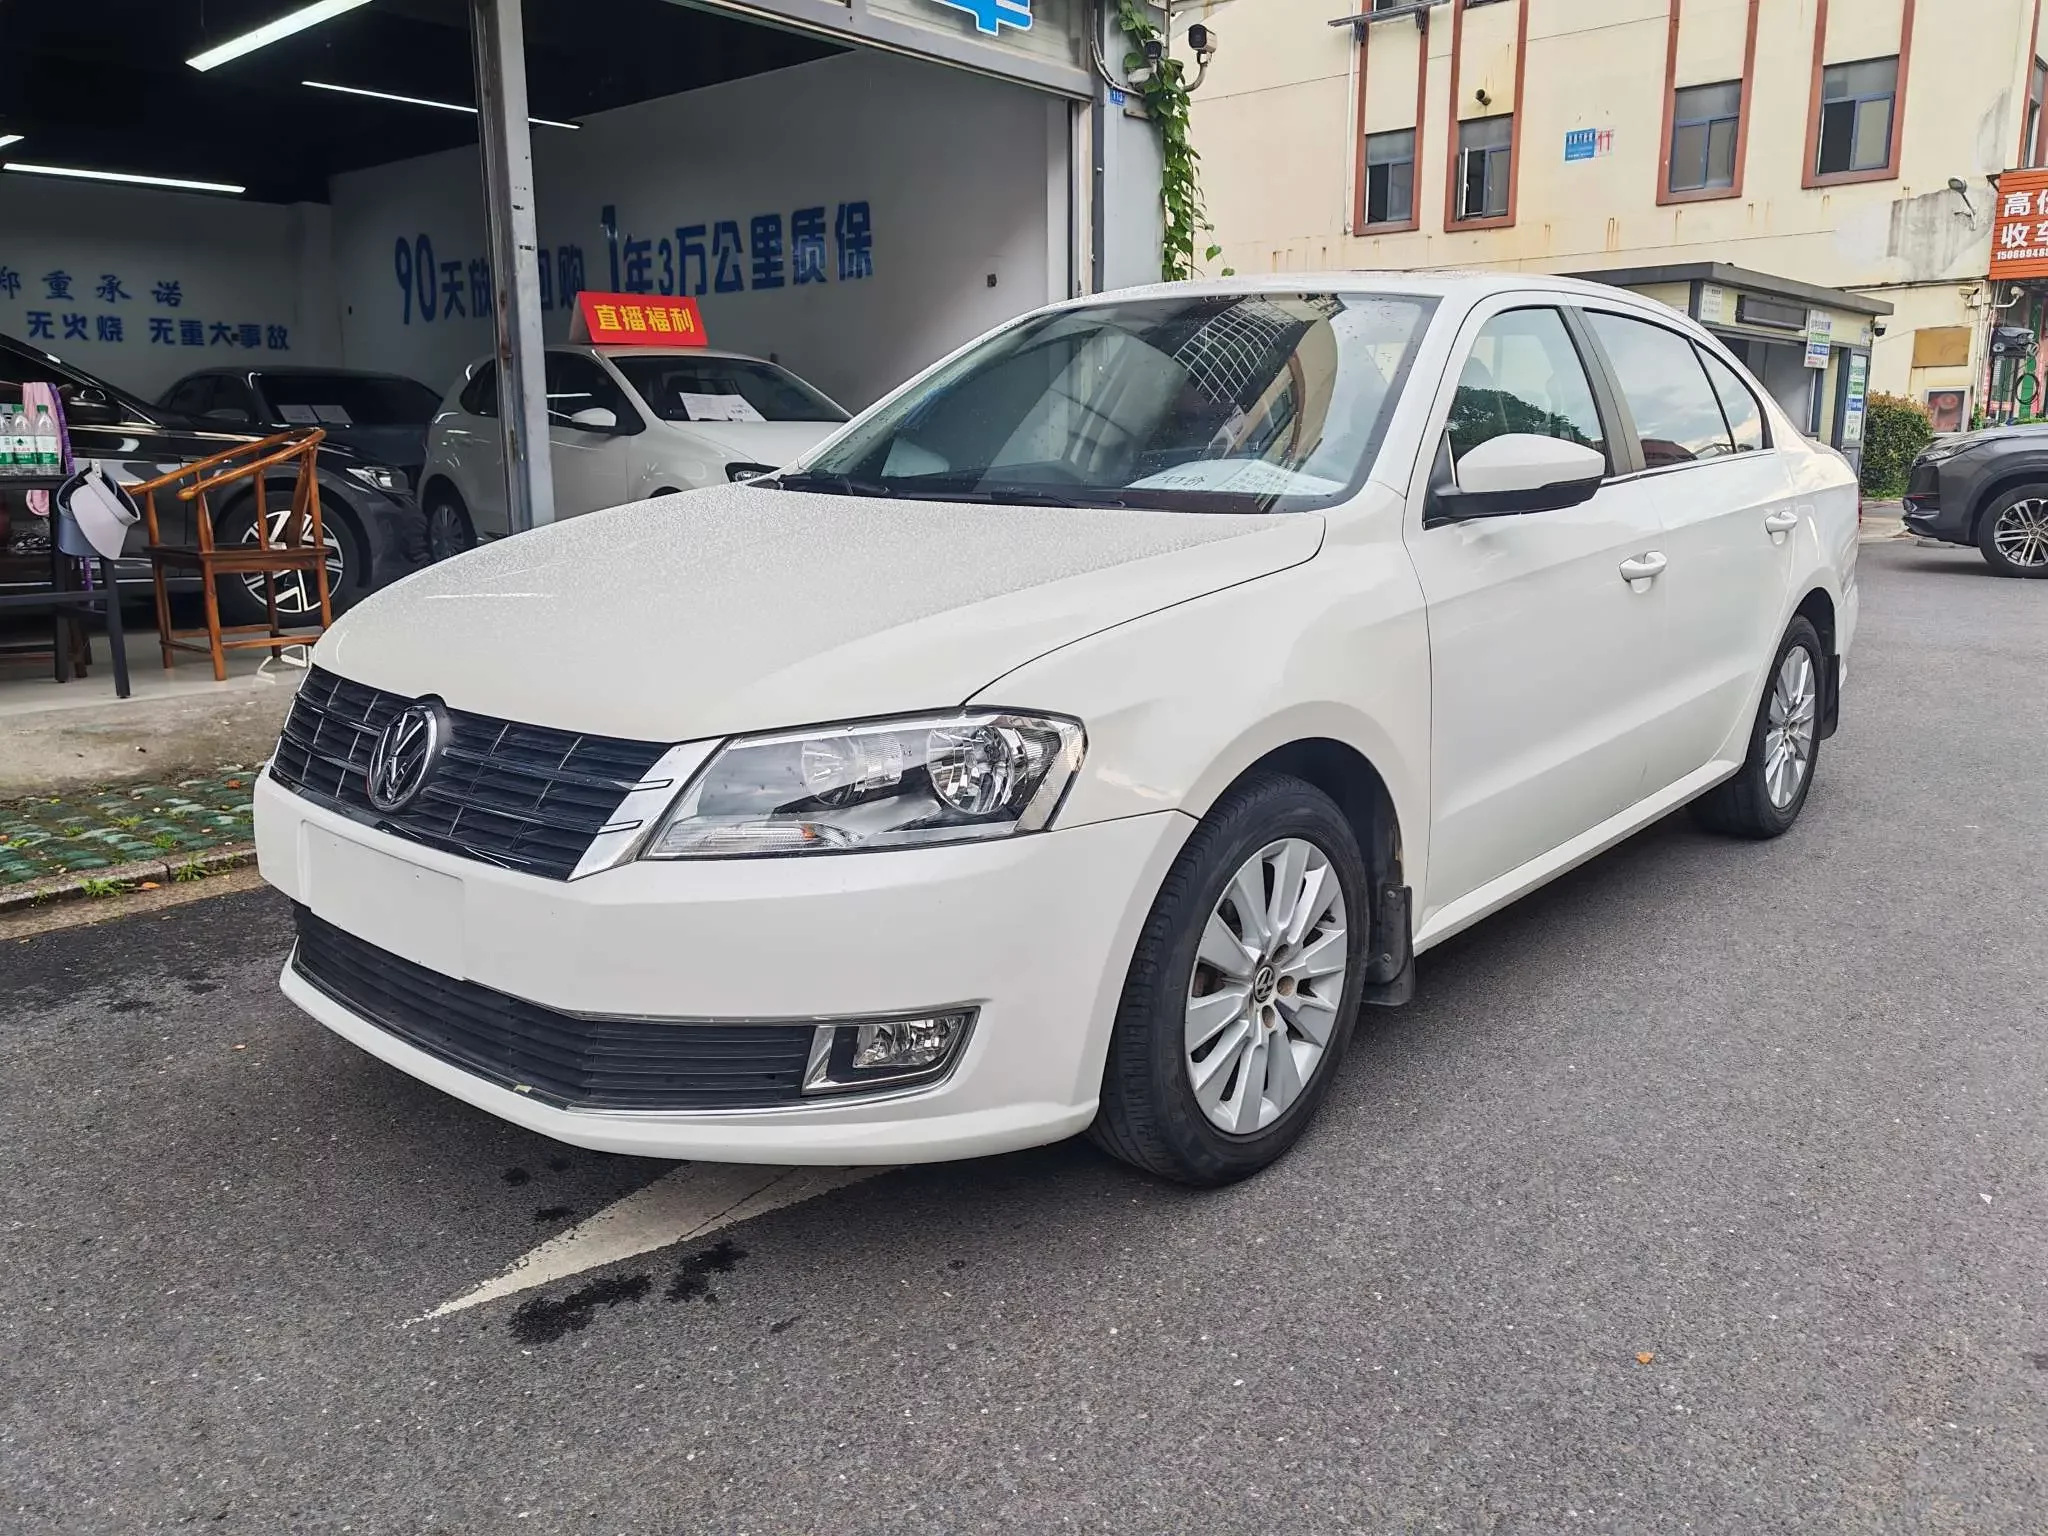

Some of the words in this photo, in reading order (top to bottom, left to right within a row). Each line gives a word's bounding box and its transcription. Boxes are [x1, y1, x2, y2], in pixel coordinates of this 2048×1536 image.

[601, 201, 873, 297] 1年3万公里质保
[27, 311, 124, 343] 无火烧
[149, 318, 290, 351] 无重大事故
[594, 304, 695, 333] 直播福利
